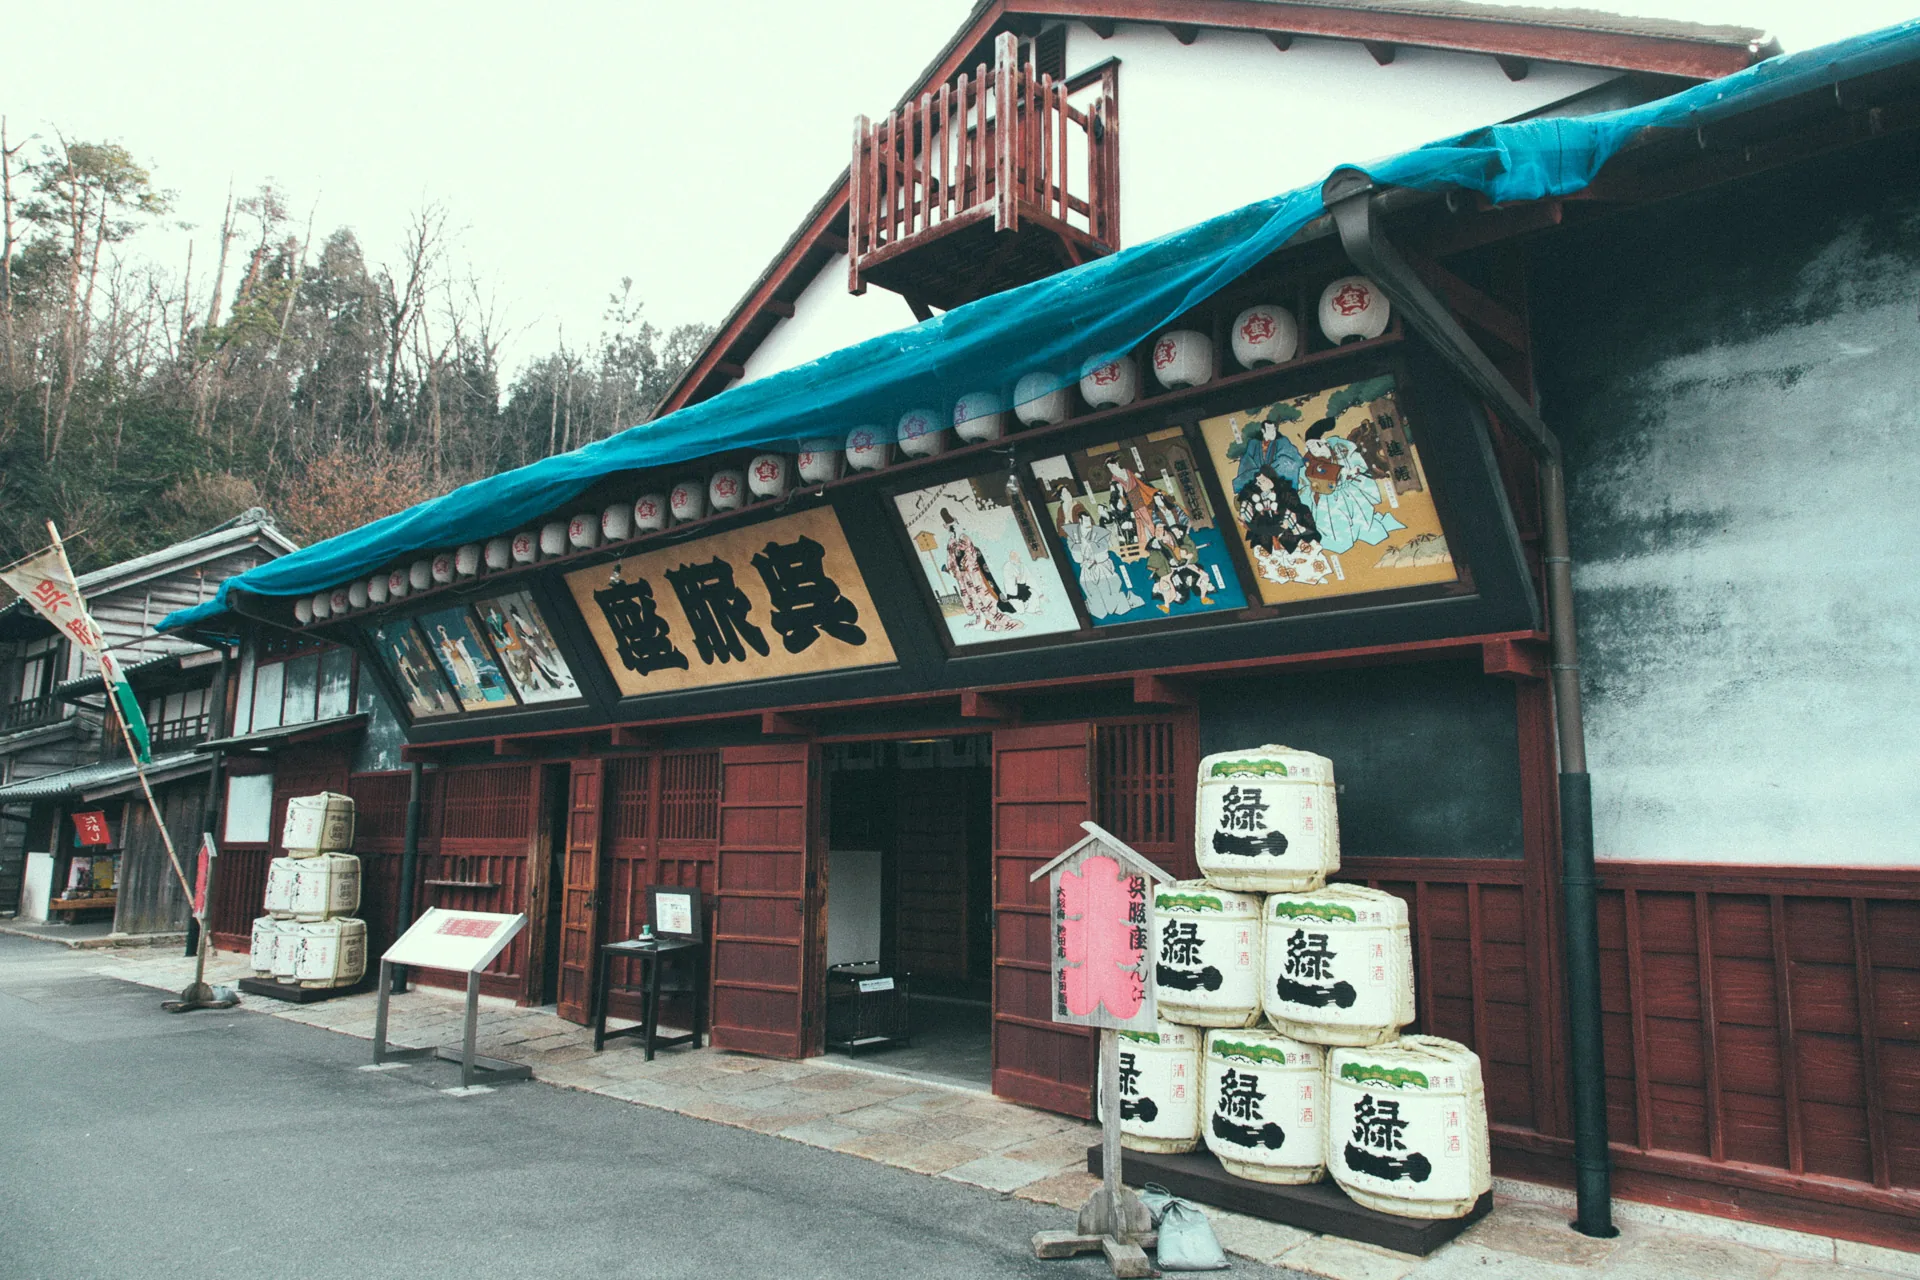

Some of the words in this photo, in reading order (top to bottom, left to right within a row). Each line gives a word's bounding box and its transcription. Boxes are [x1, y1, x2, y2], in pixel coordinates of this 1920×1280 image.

[1173, 1064, 1186, 1099] 清酒
[1300, 1085, 1313, 1123] 清酒
[1446, 1111, 1460, 1153] 清酒
